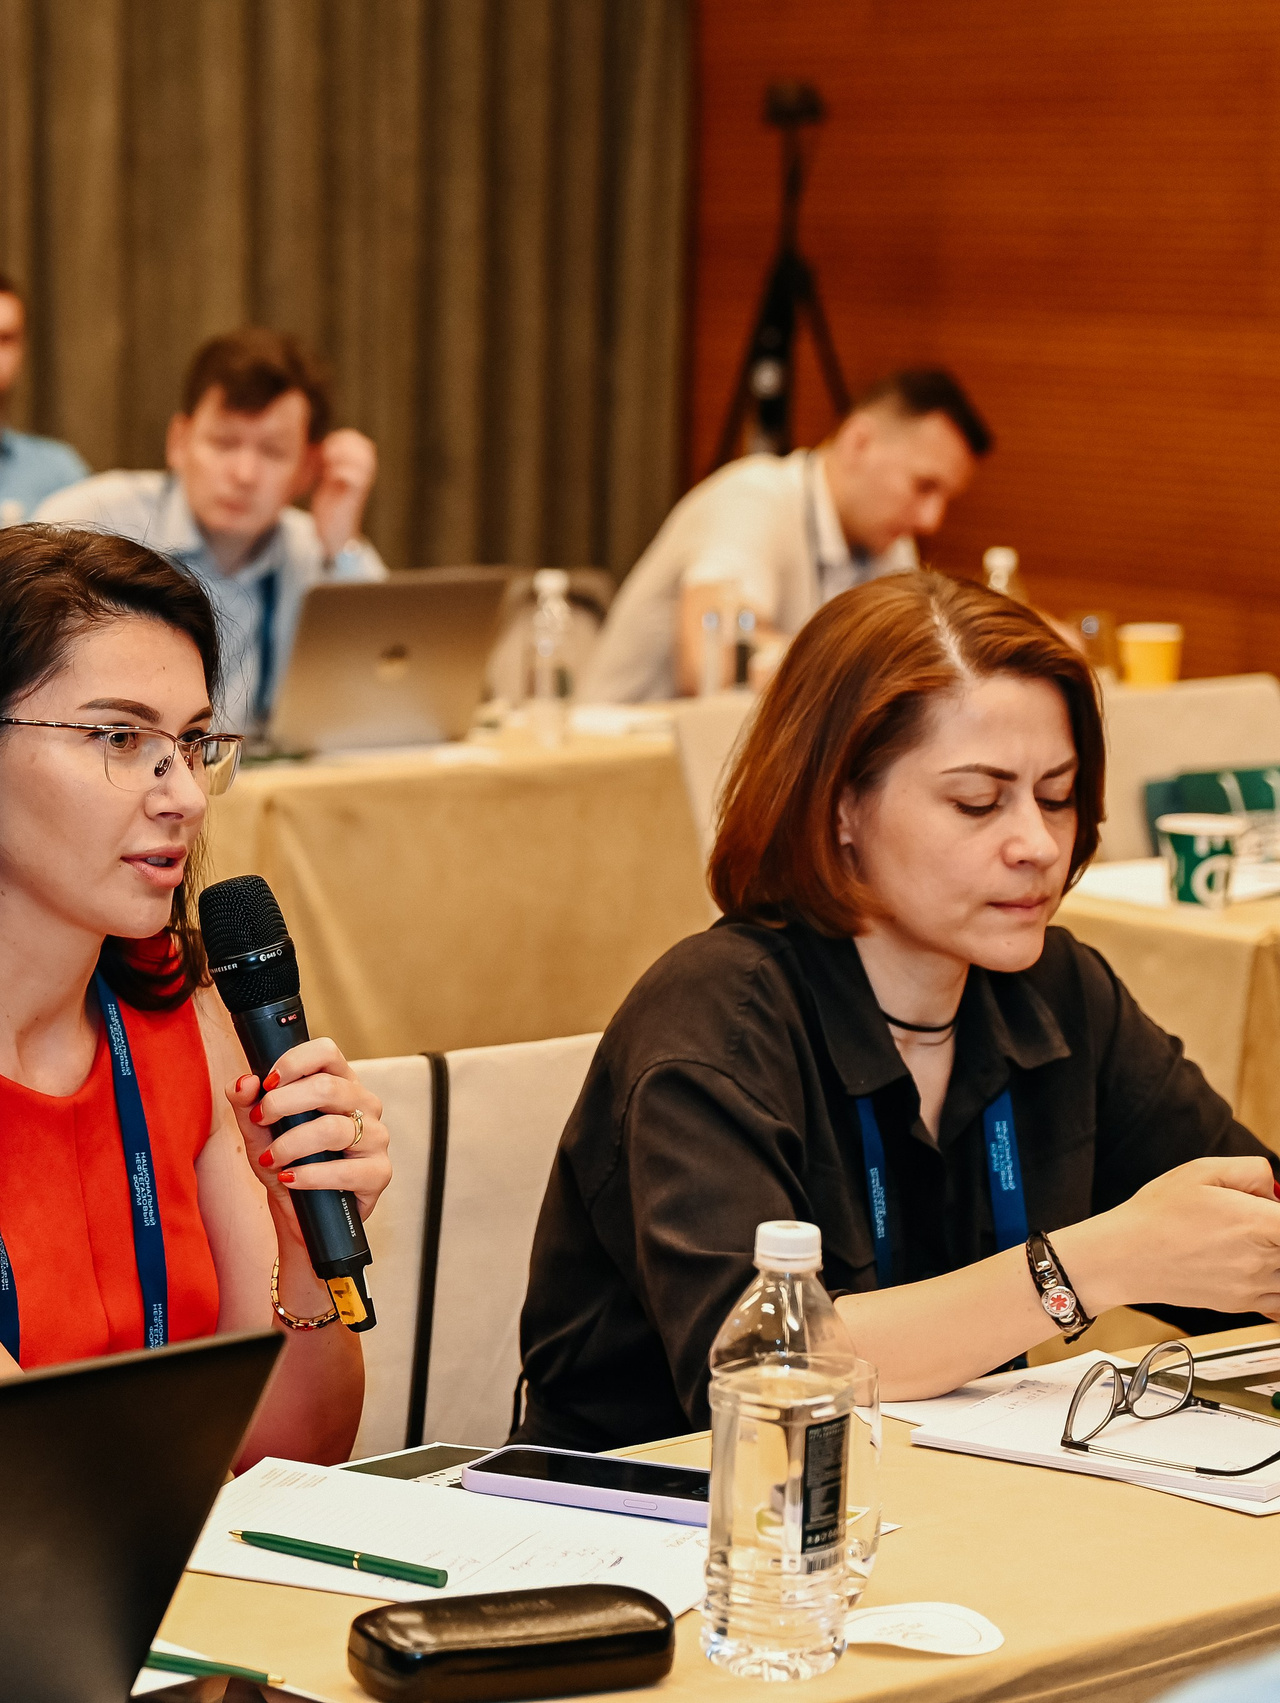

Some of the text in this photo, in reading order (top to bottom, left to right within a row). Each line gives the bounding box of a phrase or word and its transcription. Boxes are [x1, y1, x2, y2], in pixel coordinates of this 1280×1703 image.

[132, 1174, 142, 1206] ФОРУМ
[135, 1152, 151, 1227] НЕФТЕГАЗОВЫЙ
[140, 1151, 157, 1226] НАЦИОНАЛЬНЫЙ
[341, 1197, 357, 1237] SENNHEISER
